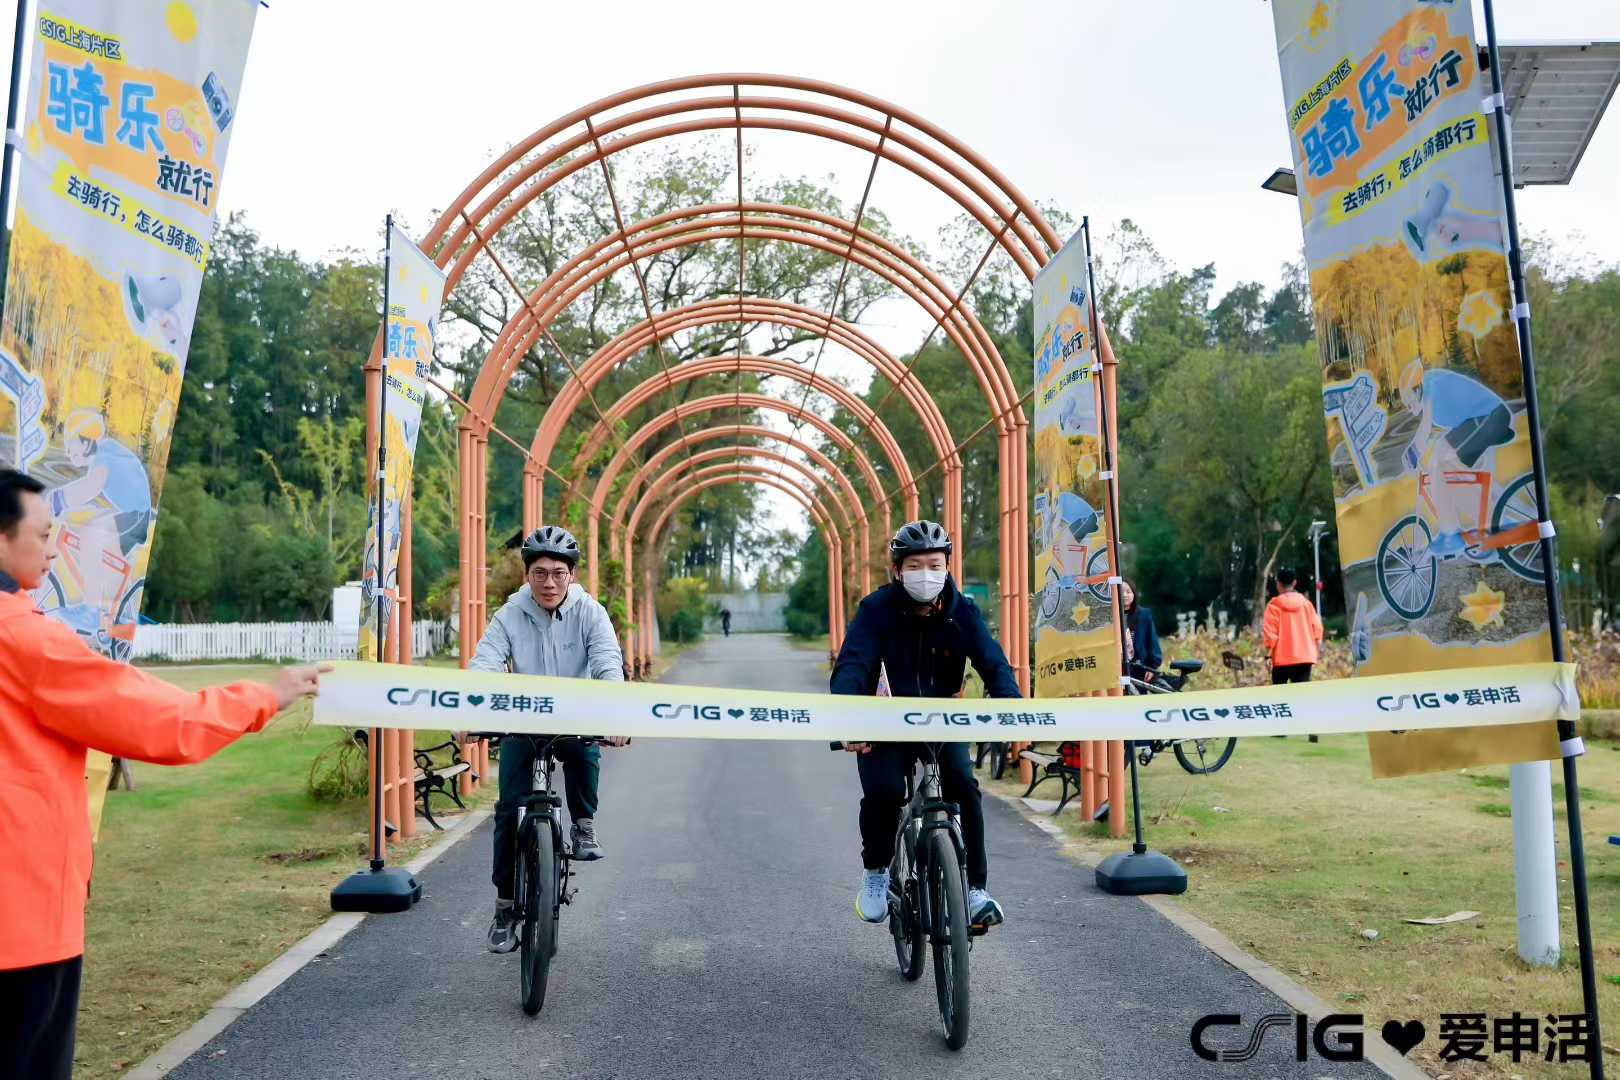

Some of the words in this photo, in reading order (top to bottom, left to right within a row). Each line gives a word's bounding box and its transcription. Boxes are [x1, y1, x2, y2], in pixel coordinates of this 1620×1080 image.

[40, 18, 122, 59] CSIG上海片区
[1301, 52, 1406, 177] 骑乐
[1403, 49, 1462, 122] 就行
[47, 61, 165, 151] 骑乐
[157, 155, 214, 206] 就行
[1343, 118, 1476, 213] 去骑行，怎么骑都行
[1064, 656, 1096, 672] 爱申活
[387, 688, 460, 708] CSIG
[490, 693, 554, 714] 爱申活
[1376, 693, 1440, 711] CSIG
[1463, 686, 1521, 706] 爱申活
[652, 703, 721, 721] CSIG
[749, 707, 811, 724] 爱申活
[904, 712, 971, 726] CSIG
[997, 711, 1057, 727] 爱申活
[1145, 707, 1210, 722] CSIG
[1233, 702, 1293, 720] 爱申活
